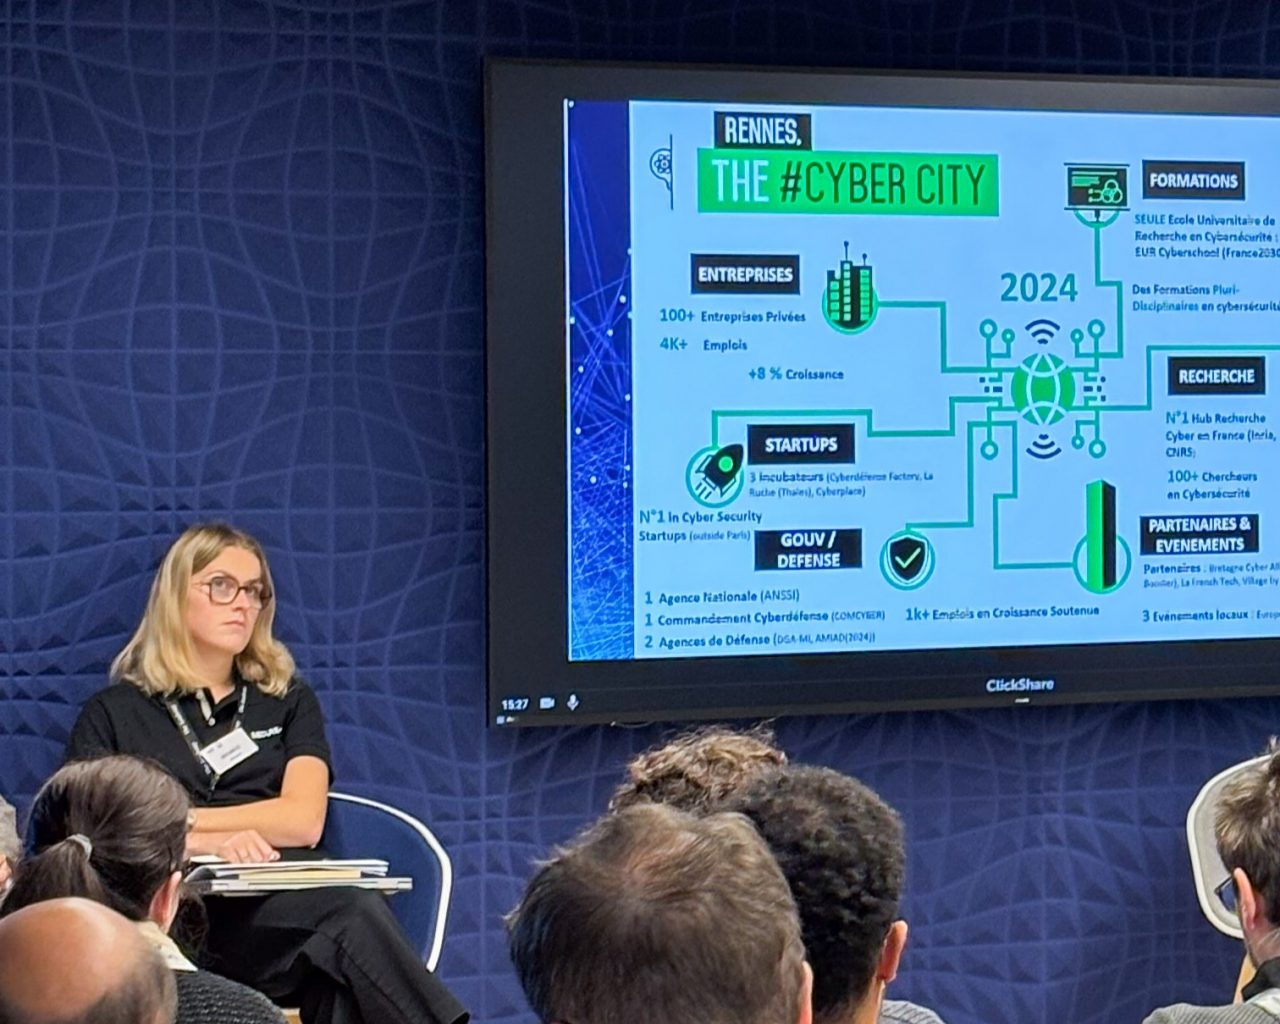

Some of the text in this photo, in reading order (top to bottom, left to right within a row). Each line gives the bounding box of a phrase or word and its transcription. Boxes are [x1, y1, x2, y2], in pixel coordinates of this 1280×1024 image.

[724, 116, 802, 146] RENNES,
[711, 159, 986, 205] THE #CYBER CITY
[1150, 173, 1238, 189] FORMATIONS
[1135, 214, 1276, 226] SEULE Ecole Universitaire de
[1135, 231, 1187, 241] Recherche
[1190, 233, 1203, 241] en
[1205, 231, 1273, 244] Cybersécurité
[1135, 247, 1156, 257] EUR
[1159, 247, 1220, 259] Cyberschool
[698, 267, 793, 283] ENTREPRISES
[1001, 273, 1078, 302] 2024
[1132, 284, 1240, 295] Des Formations Pluri-
[1132, 301, 1199, 313] Disciplinaires
[1201, 304, 1214, 312] en
[660, 309, 806, 324] 100+ Entreprises Privées
[660, 337, 748, 352] 4K+ Emplois
[749, 367, 844, 380] +8 % Croissance
[1179, 369, 1255, 384] RECHERCHE
[1166, 411, 1266, 424] N°1 Hub Recherche
[1166, 430, 1195, 443] Cyber
[1212, 430, 1245, 440] France
[765, 437, 838, 452] STARTUPS
[749, 473, 756, 482] 3
[1168, 470, 1258, 483] 100+ Chercheurs
[1167, 489, 1251, 501] en Cybersécurité
[639, 510, 664, 524] N°1
[682, 511, 714, 524] Cyber
[717, 510, 763, 524] Security
[1149, 517, 1251, 532] PARTENAIRES &
[639, 531, 687, 543] Startups
[781, 530, 837, 549] GOUV /
[1155, 538, 1245, 553] EVENEMENTS
[777, 553, 841, 568] DEFENSE
[1143, 562, 1201, 574] Partenaires
[645, 589, 800, 606] 1 Agence Nationale (ANSSI)
[645, 613, 653, 626] 1
[754, 610, 829, 625] Cyberdéfense
[906, 605, 1100, 621] 1k+ Emplois en Croissance Soutenue
[1142, 610, 1150, 622] 3
[1216, 608, 1249, 620] locaux
[645, 635, 653, 648] 2
[659, 636, 706, 649] Agences
[708, 635, 723, 646] de
[725, 633, 770, 646] Défense
[986, 678, 1055, 692] ClickShare
